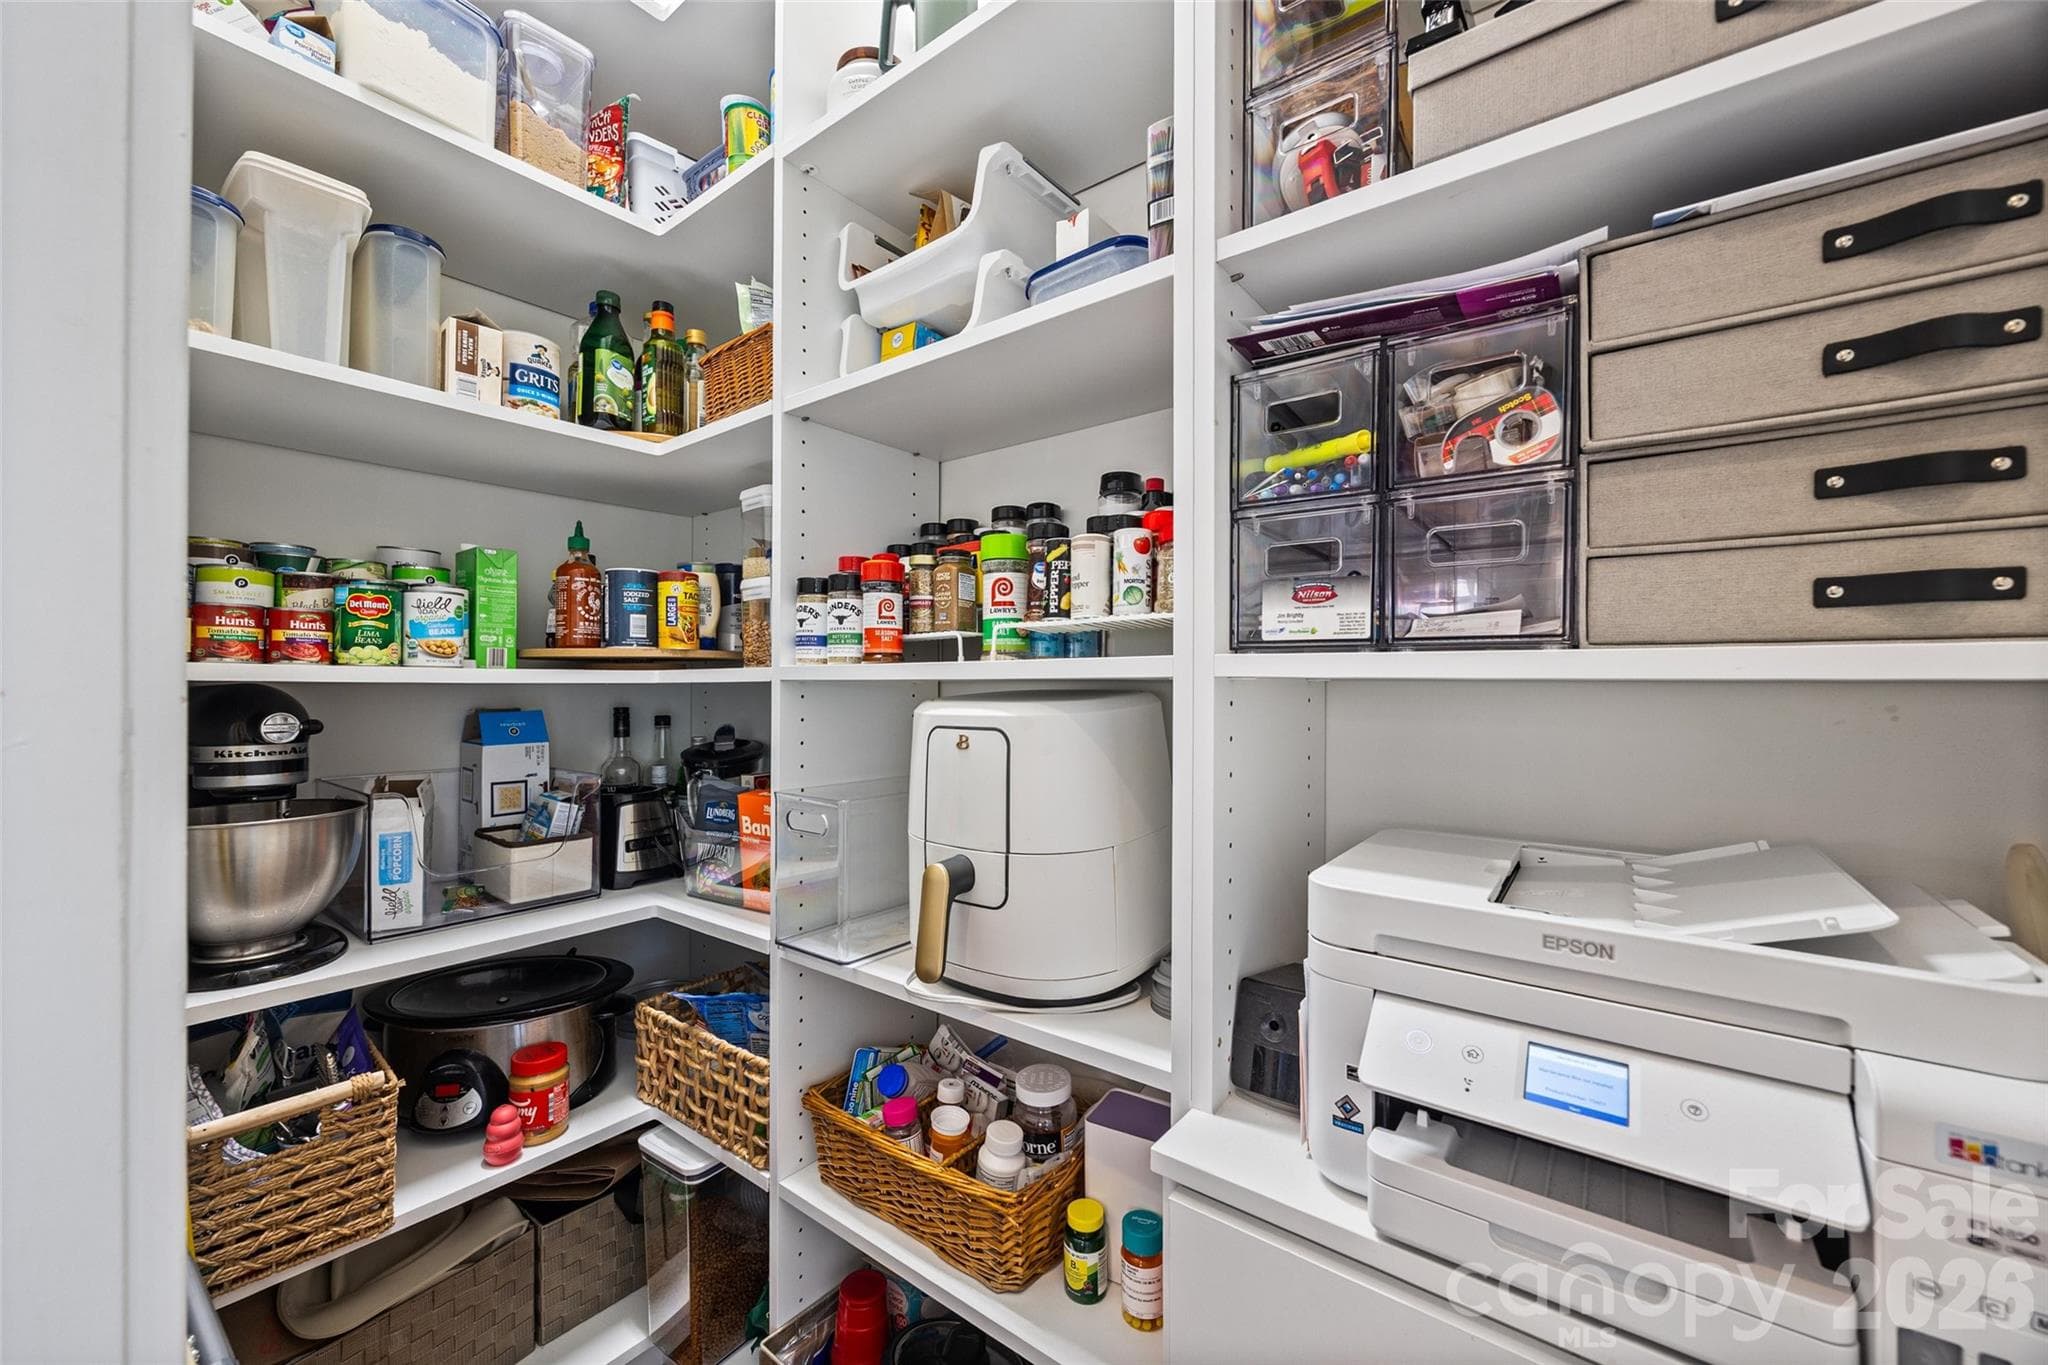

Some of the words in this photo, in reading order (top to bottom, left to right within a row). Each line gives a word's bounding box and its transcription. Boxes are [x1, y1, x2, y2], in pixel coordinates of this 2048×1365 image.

[527, 356, 552, 370] QUAKER
[514, 368, 559, 393] GRITS
[1498, 393, 1532, 413] Scotch
[1049, 570, 1060, 613] PEPPER
[1297, 590, 1333, 600] Nilson
[349, 600, 362, 609] Del
[363, 600, 389, 610] Monte
[411, 596, 452, 614] field
[828, 602, 862, 616] INDER'S
[357, 629, 380, 638] LIMA
[428, 628, 456, 636] BEANS
[354, 636, 383, 645] BEANS
[213, 746, 308, 759] KitchenAid
[706, 807, 736, 821] LUNDBERG
[742, 815, 770, 837] Ban
[393, 835, 403, 881] POPCORN
[1542, 933, 1617, 961] EPSON
